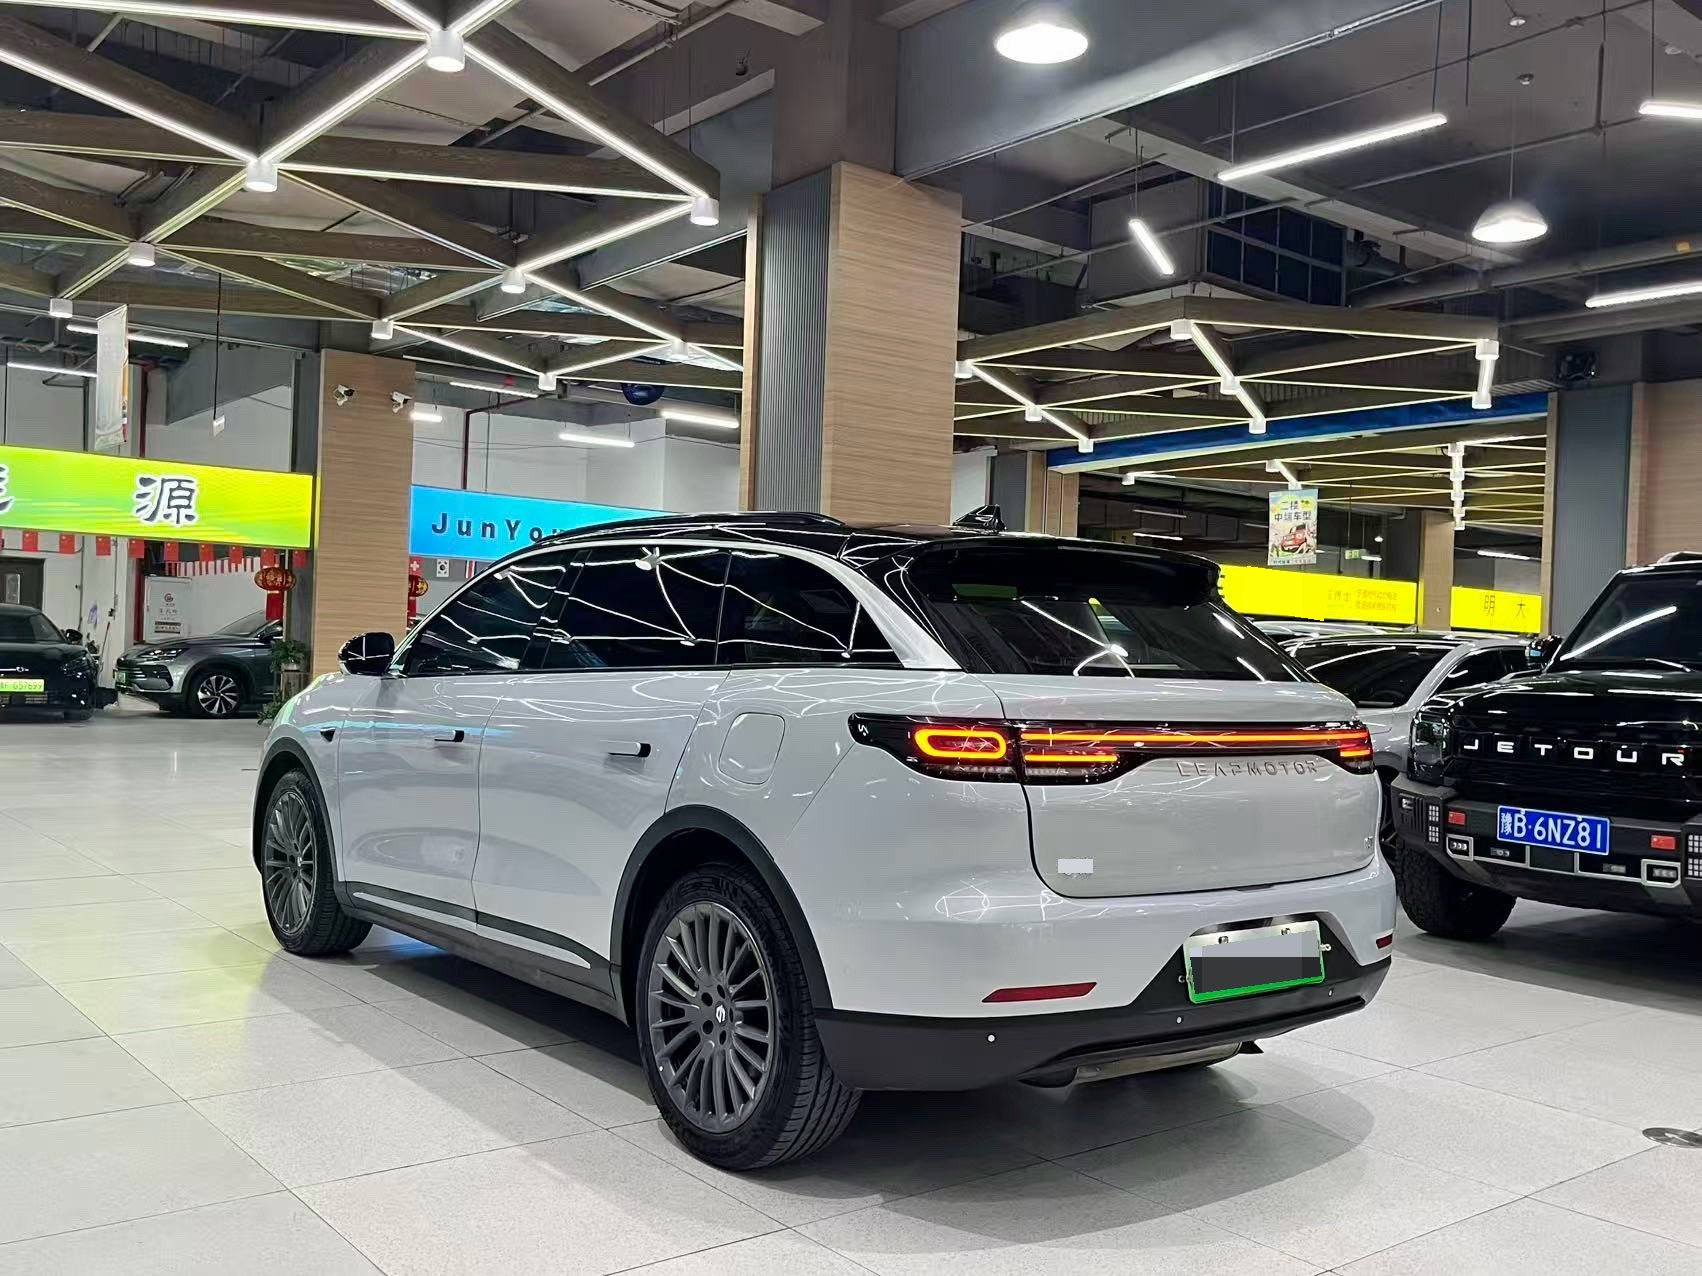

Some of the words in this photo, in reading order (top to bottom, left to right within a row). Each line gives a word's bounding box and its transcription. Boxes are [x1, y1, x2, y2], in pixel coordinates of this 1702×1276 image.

[134, 476, 197, 524] 源
[431, 512, 566, 543] JunYo
[1463, 738, 1685, 767] JETOUR
[1176, 760, 1318, 777] LEAPMOTOR
